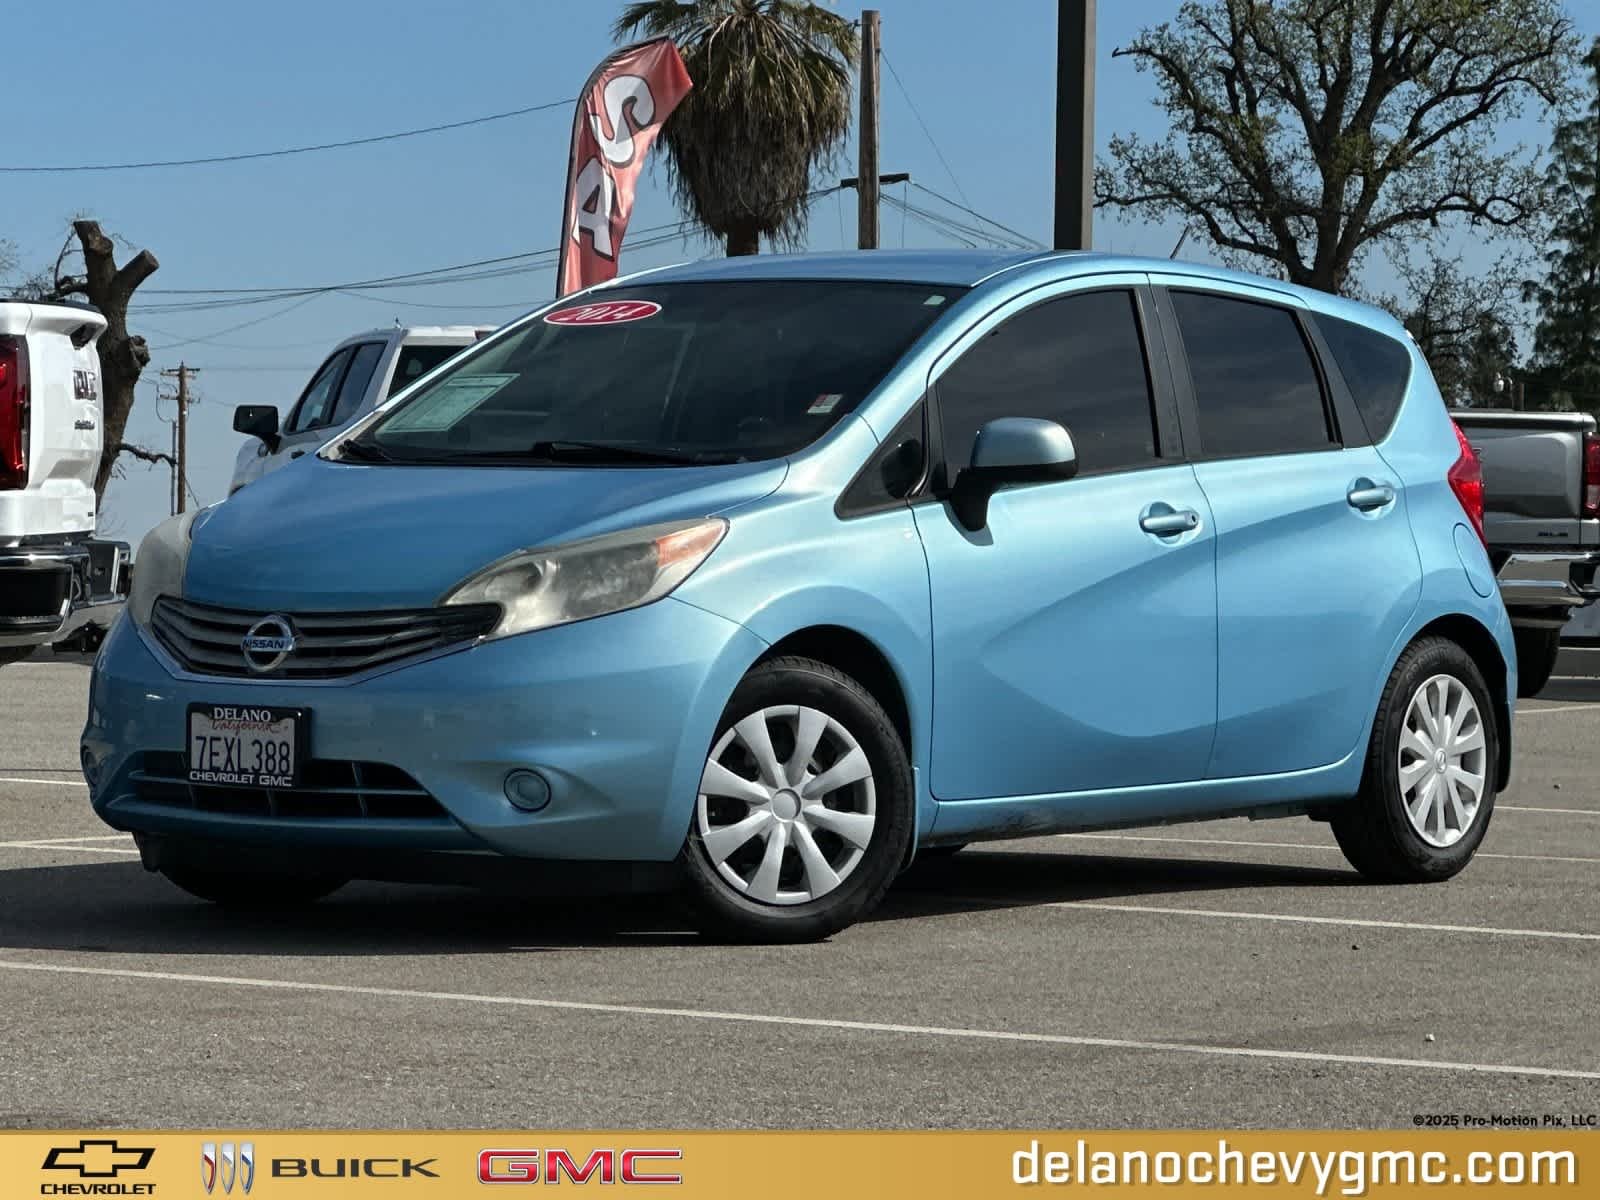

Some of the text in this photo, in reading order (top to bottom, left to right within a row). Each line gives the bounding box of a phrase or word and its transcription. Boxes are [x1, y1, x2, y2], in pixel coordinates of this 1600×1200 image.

[555, 304, 652, 322] 2014
[242, 639, 285, 649] NISSAN
[213, 707, 272, 722] DELANO
[195, 735, 291, 775] 7EXL388
[189, 770, 293, 787] CHEVROLET GMC
